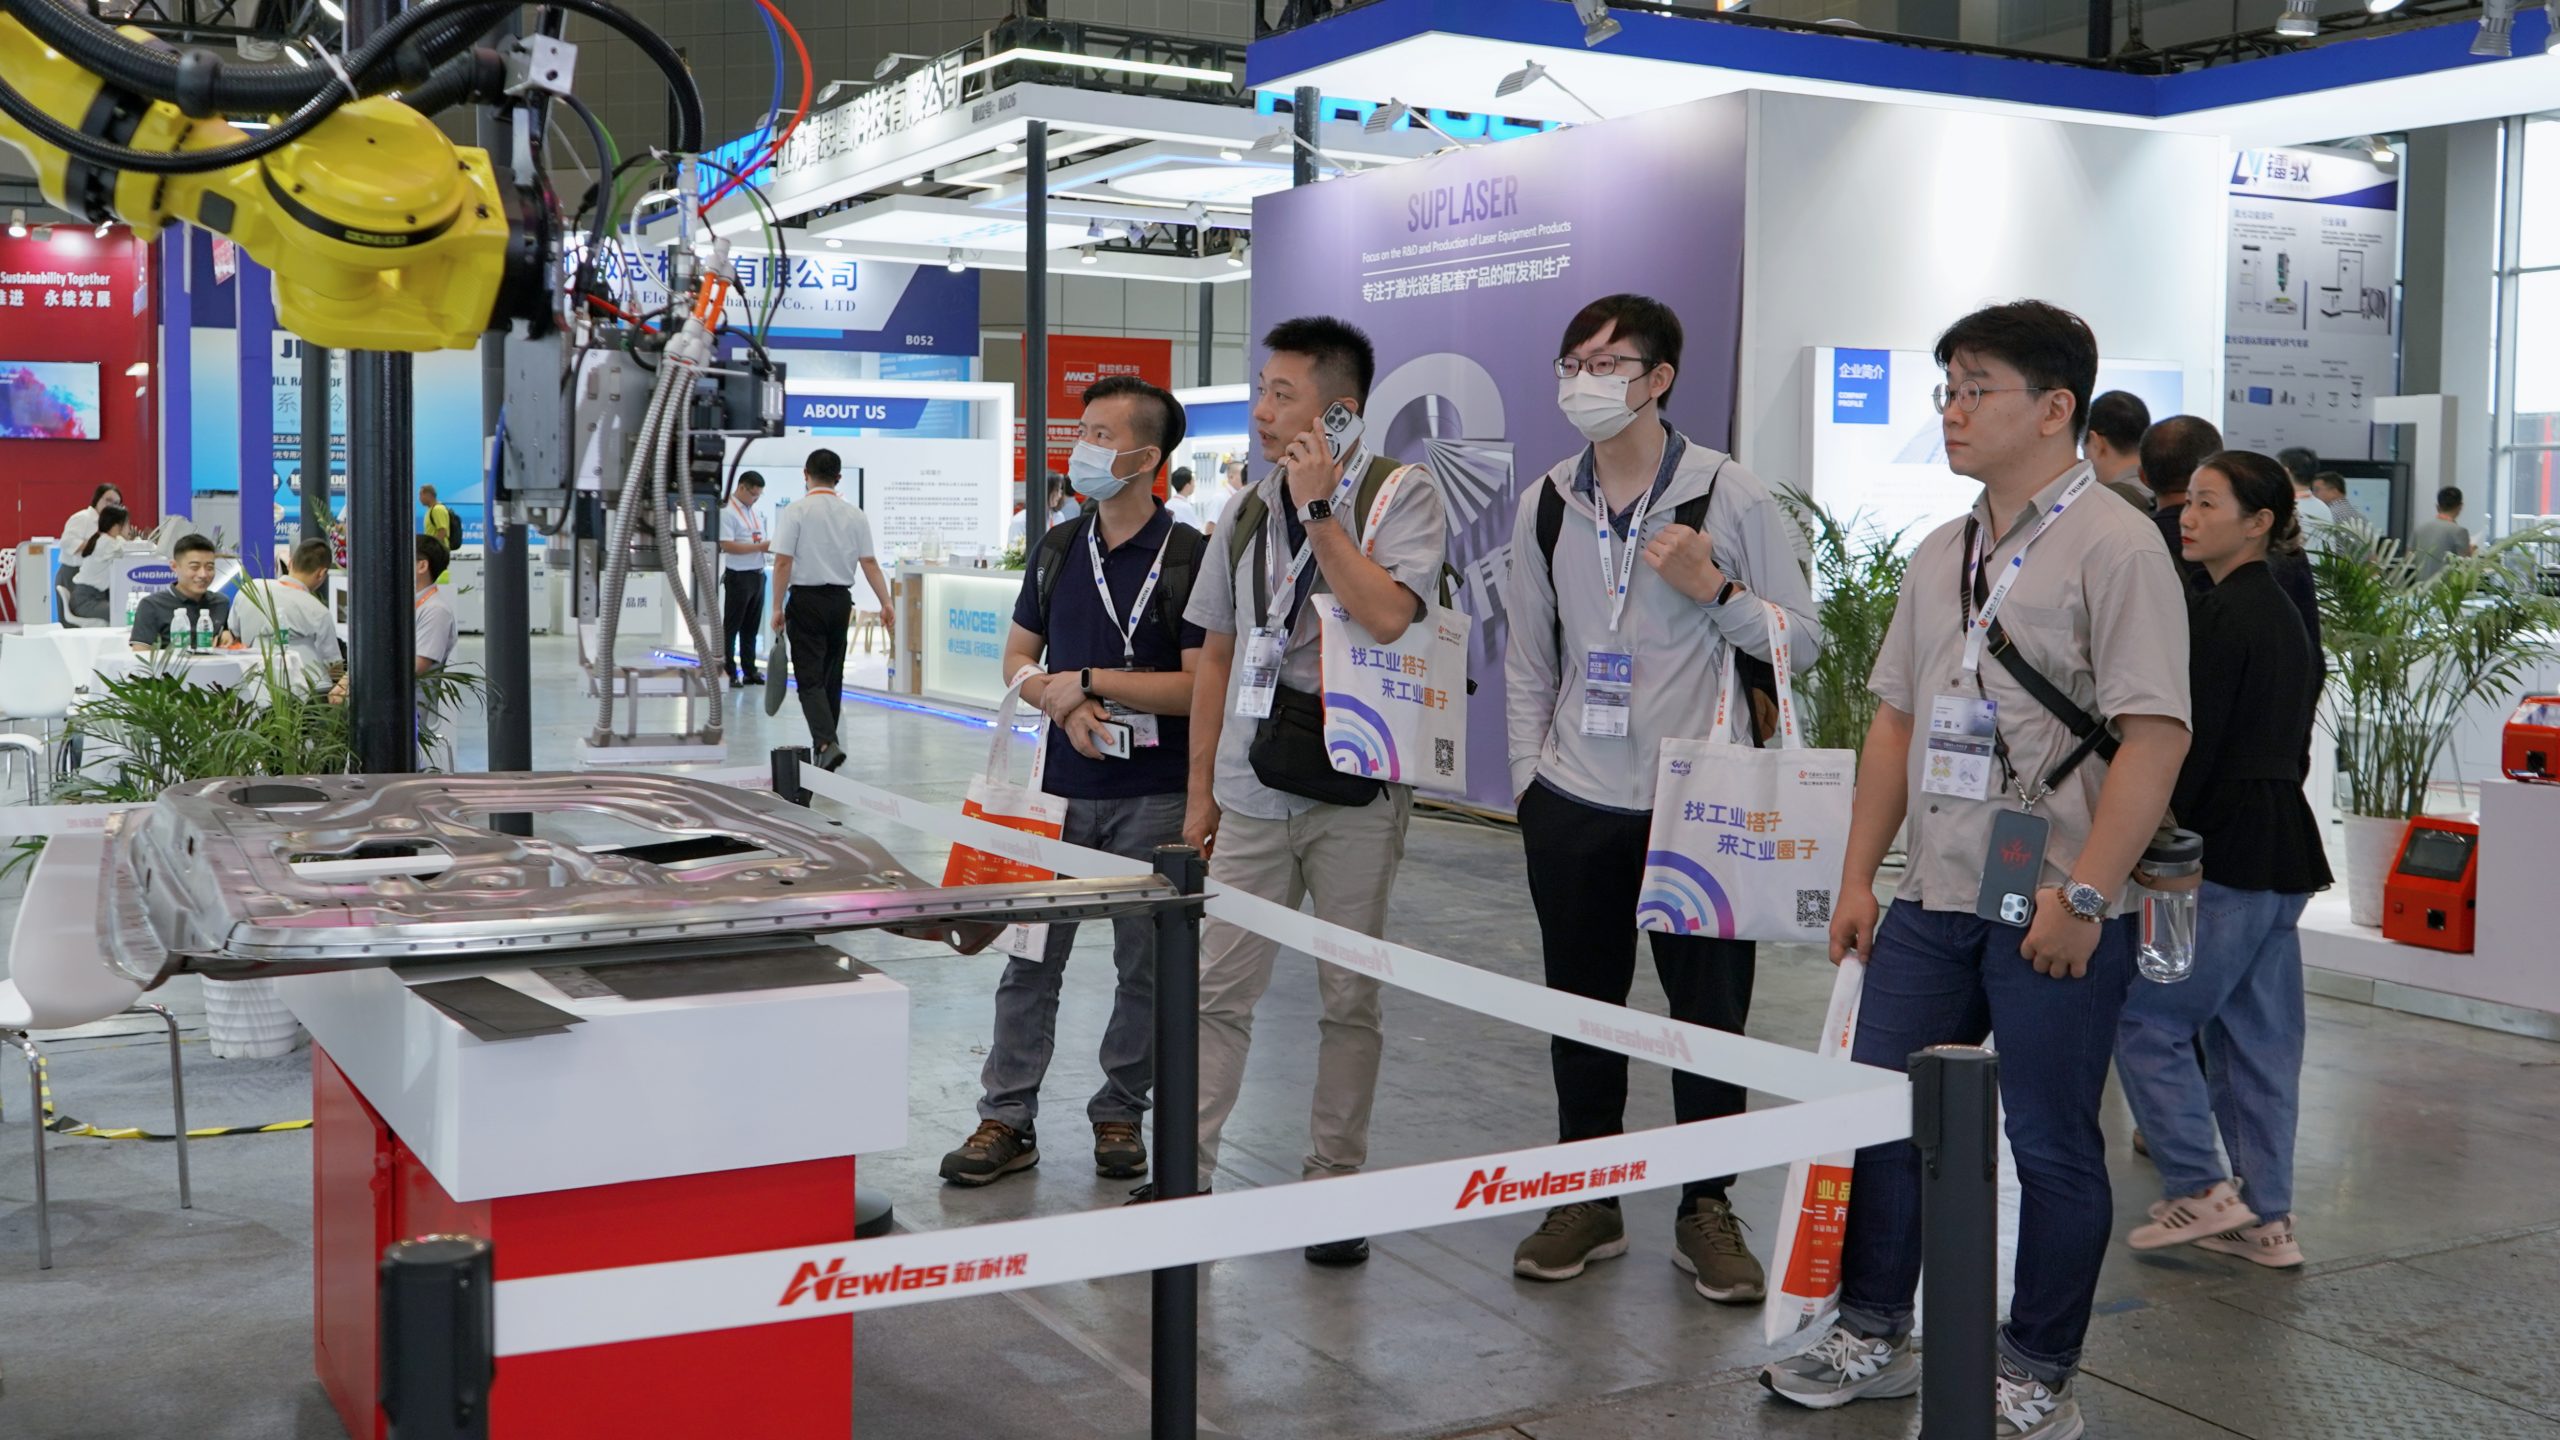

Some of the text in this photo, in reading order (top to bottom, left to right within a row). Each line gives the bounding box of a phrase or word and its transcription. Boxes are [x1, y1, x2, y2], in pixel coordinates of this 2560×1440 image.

[1407, 174, 1519, 233] SUPLASER
[1362, 220, 1572, 264] Focus on the R&D and Production of Laser Equipment Products
[0, 272, 110, 287] Sustainability Together
[1362, 254, 1571, 304] 专注于激光设备配套产品的研发和生产
[44, 290, 111, 308] 永续发展
[824, 299, 856, 312] LTD
[905, 333, 934, 347] B052
[1838, 363, 1885, 380] 企业简介
[802, 403, 887, 420] ABOUT US
[2067, 474, 2091, 498] TRUMPF
[1623, 547, 1633, 574] TRUMPF
[625, 596, 648, 608] 品质
[949, 607, 997, 635] RAYCEE
[1350, 646, 1428, 679] 找工业搭子
[1381, 677, 1449, 711] 来工业圈子
[1683, 800, 1783, 833] 找工业搭子
[1716, 834, 1820, 861] 来工业圈子
[1454, 1160, 1648, 1210] Newlas 新耐视
[777, 1252, 1030, 1307] Newlas 新耐视
